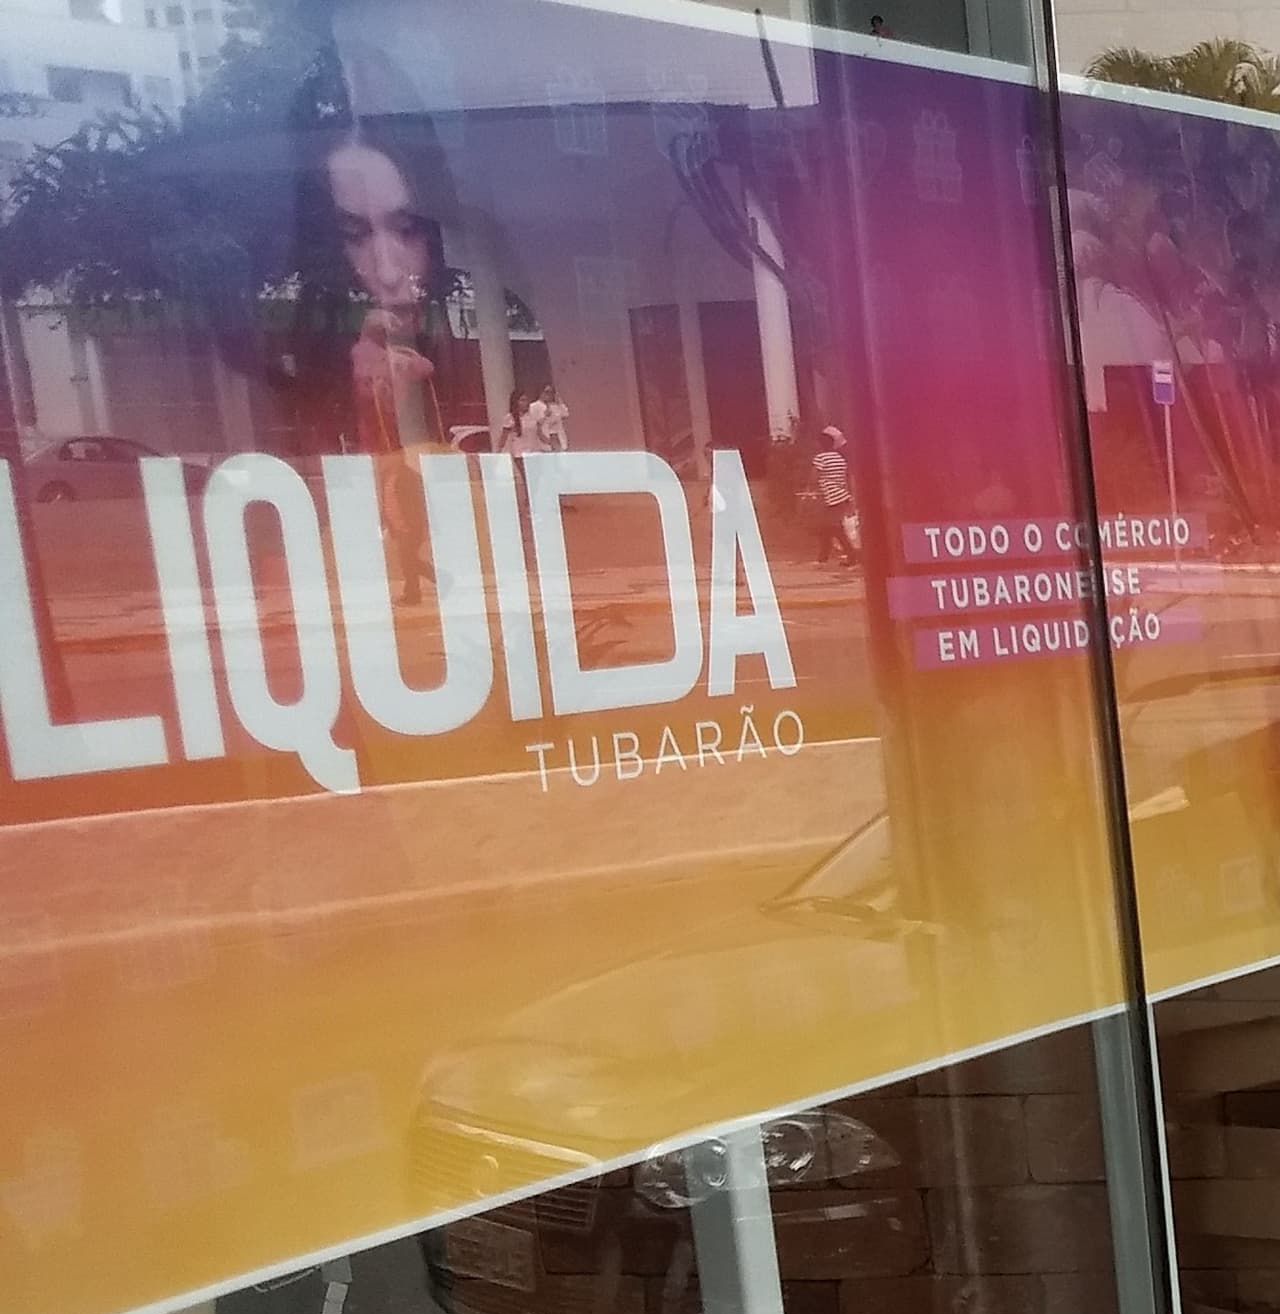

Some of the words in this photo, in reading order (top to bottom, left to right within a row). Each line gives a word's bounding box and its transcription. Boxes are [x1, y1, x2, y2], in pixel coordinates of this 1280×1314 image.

[925, 524, 1009, 558] TODO
[1023, 523, 1043, 552] O
[0, 449, 796, 795] LIQUIDA
[938, 629, 979, 662] EM
[993, 608, 1160, 656] LIQUIDÇÃO
[525, 704, 804, 793] TUBARÃO
